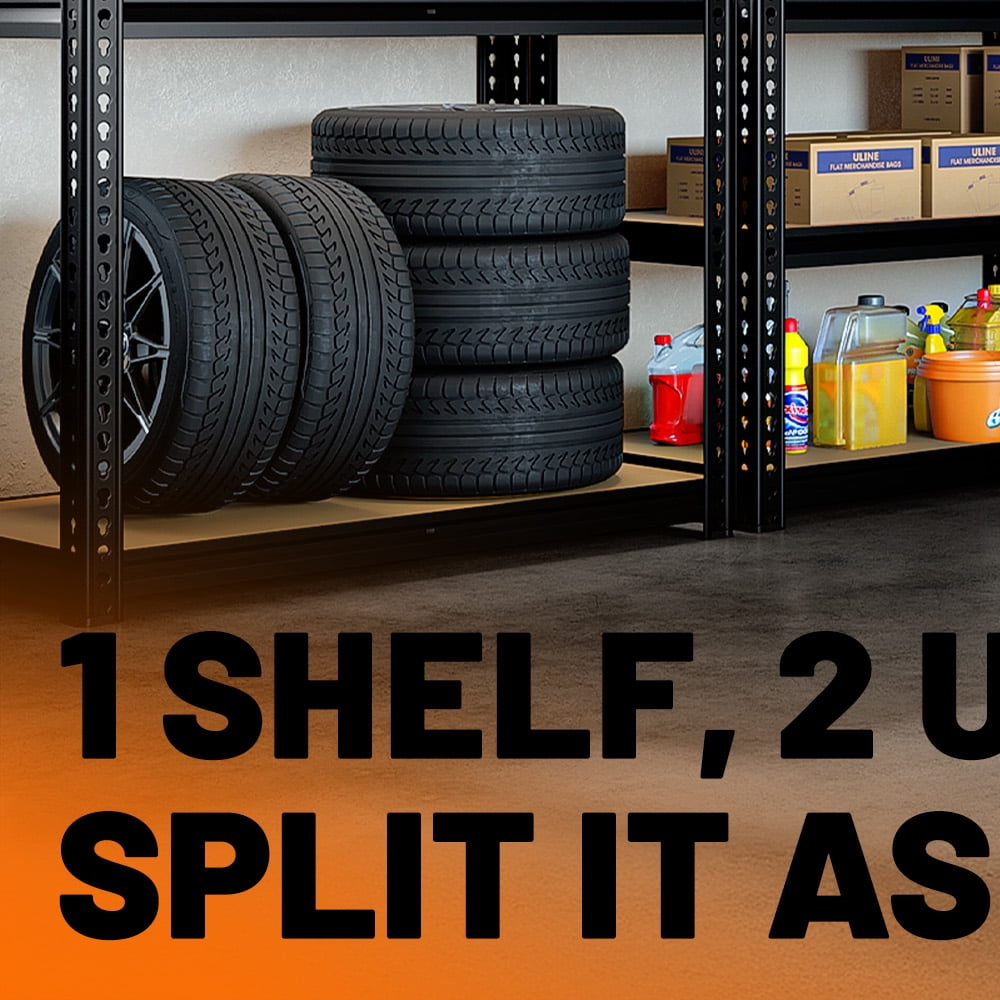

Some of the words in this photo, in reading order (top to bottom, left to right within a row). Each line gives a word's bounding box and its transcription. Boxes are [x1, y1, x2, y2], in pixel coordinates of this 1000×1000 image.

[852, 151, 879, 162] ULINE
[971, 147, 996, 157] ULINE
[830, 163, 843, 171] FLAT
[886, 160, 902, 169] BAGS
